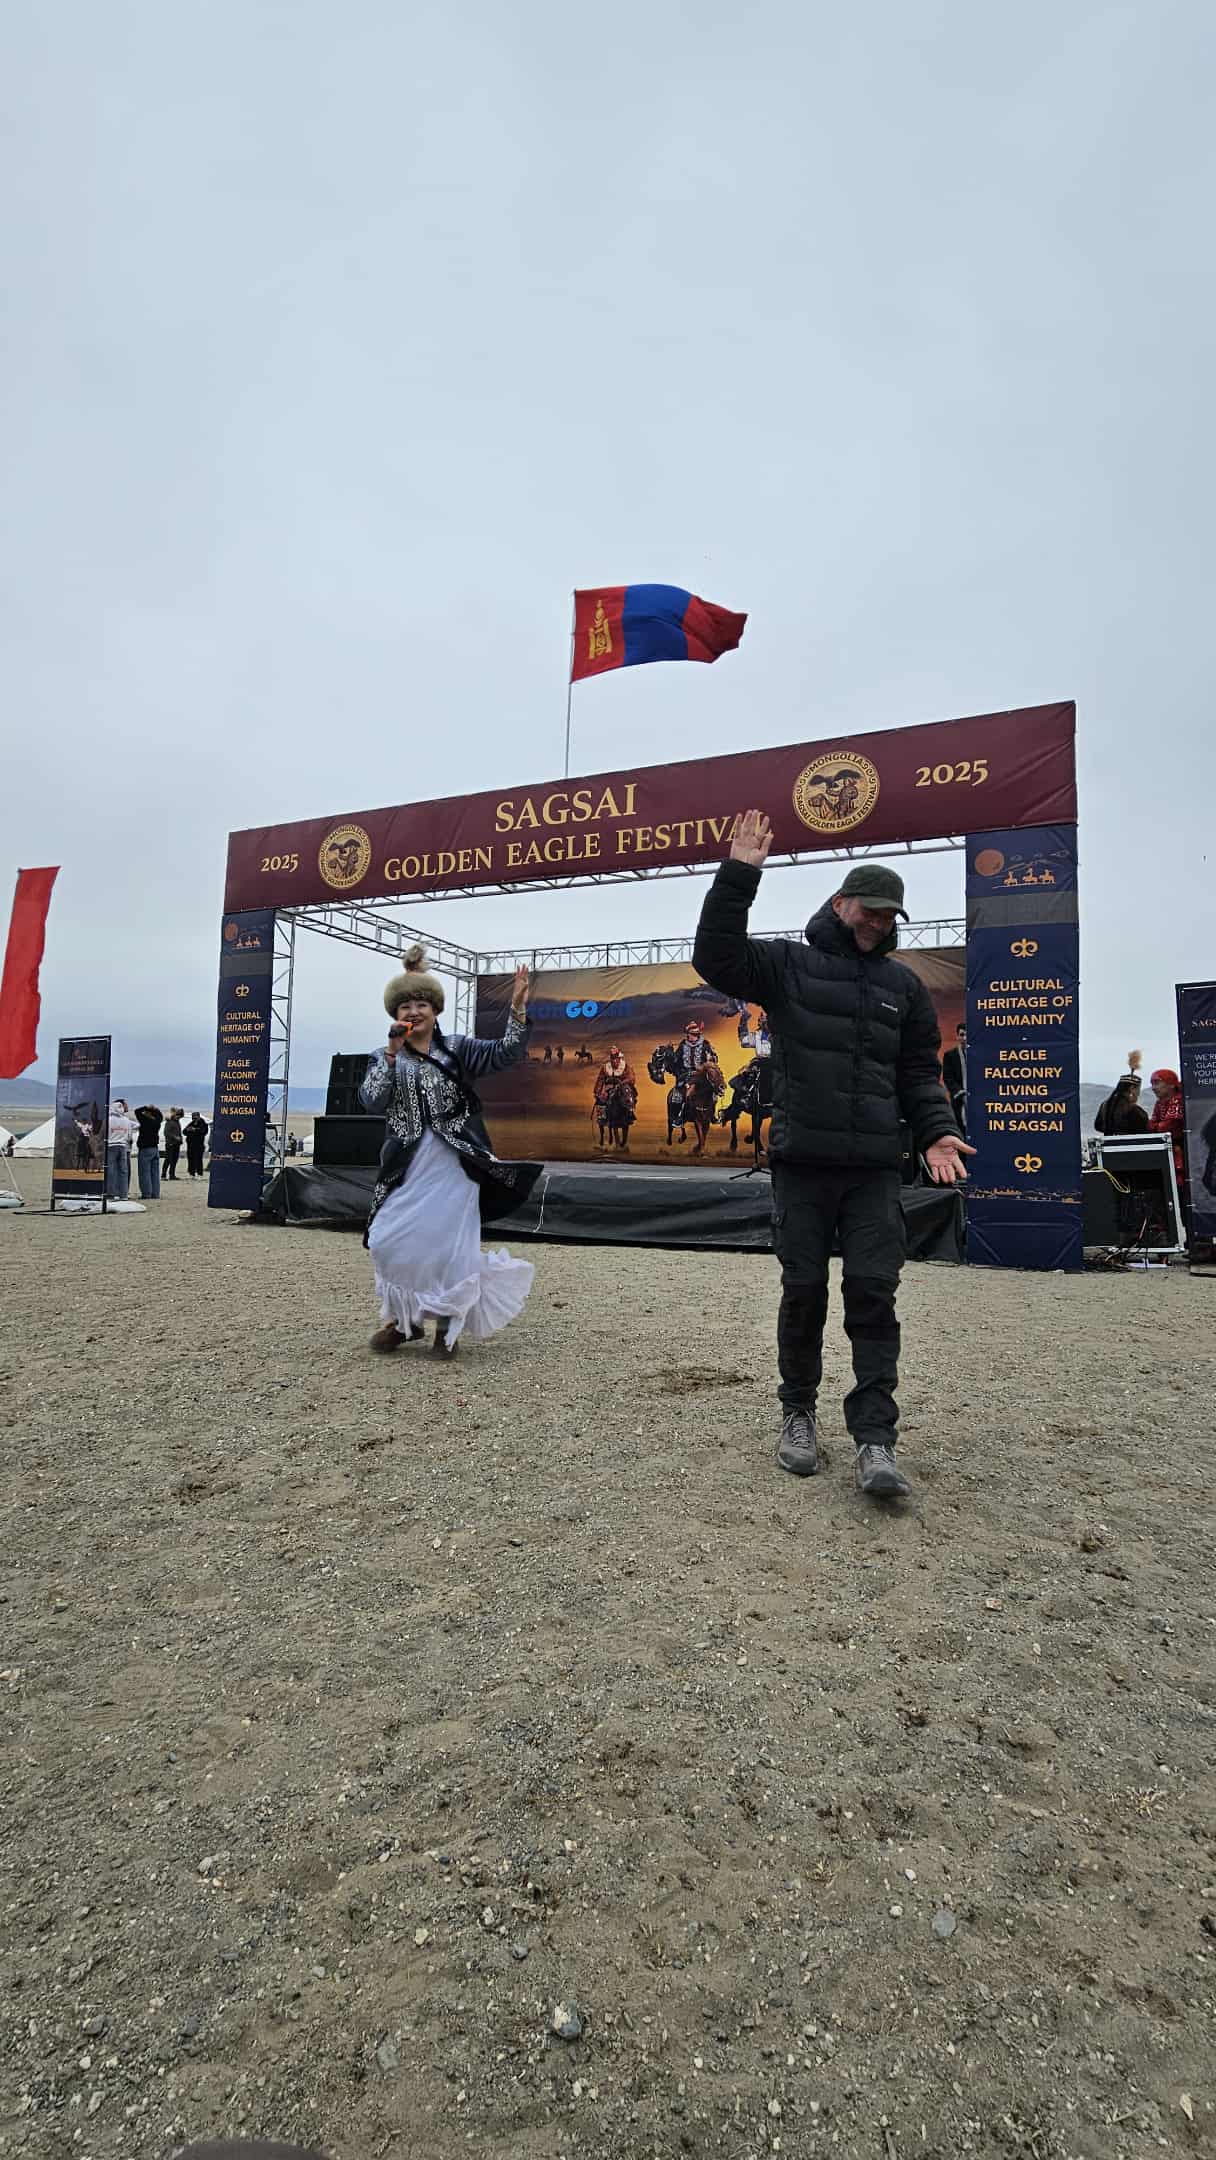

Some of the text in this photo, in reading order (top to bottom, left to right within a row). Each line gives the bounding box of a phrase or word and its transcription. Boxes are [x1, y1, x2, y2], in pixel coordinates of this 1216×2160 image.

[808, 752, 864, 774] MONGOLIA
[915, 759, 990, 787] 2025
[494, 783, 638, 833] SAGSAI
[809, 817, 836, 830] GOLDEN
[836, 815, 859, 829] EAGLE
[858, 785, 877, 819] FESTIVAL
[260, 853, 299, 872] 2025
[384, 846, 494, 881] GOLDEN
[506, 832, 602, 867] EAGLE
[989, 978, 1065, 992] CULTURAL
[976, 995, 1073, 1010] HERITAGE OF
[226, 1011, 262, 1020] CULTURAL
[984, 1013, 1065, 1027] HUMANITY
[220, 1023, 265, 1032] HERITAGE OF
[223, 1035, 261, 1045] HUMANITY
[999, 1049, 1048, 1061] EAGLE
[227, 1059, 251, 1067] EAGLE
[220, 1071, 257, 1080] FALCONRY
[984, 1066, 1063, 1079] FALCONRY
[226, 1083, 250, 1091] LIVING
[998, 1084, 1049, 1096] LIVING
[220, 1095, 257, 1103] TRADITION
[220, 1107, 256, 1115] IN SAGSAI
[984, 1102, 1067, 1114] TRADITION
[989, 1119, 1063, 1132] IN SAGSAI
